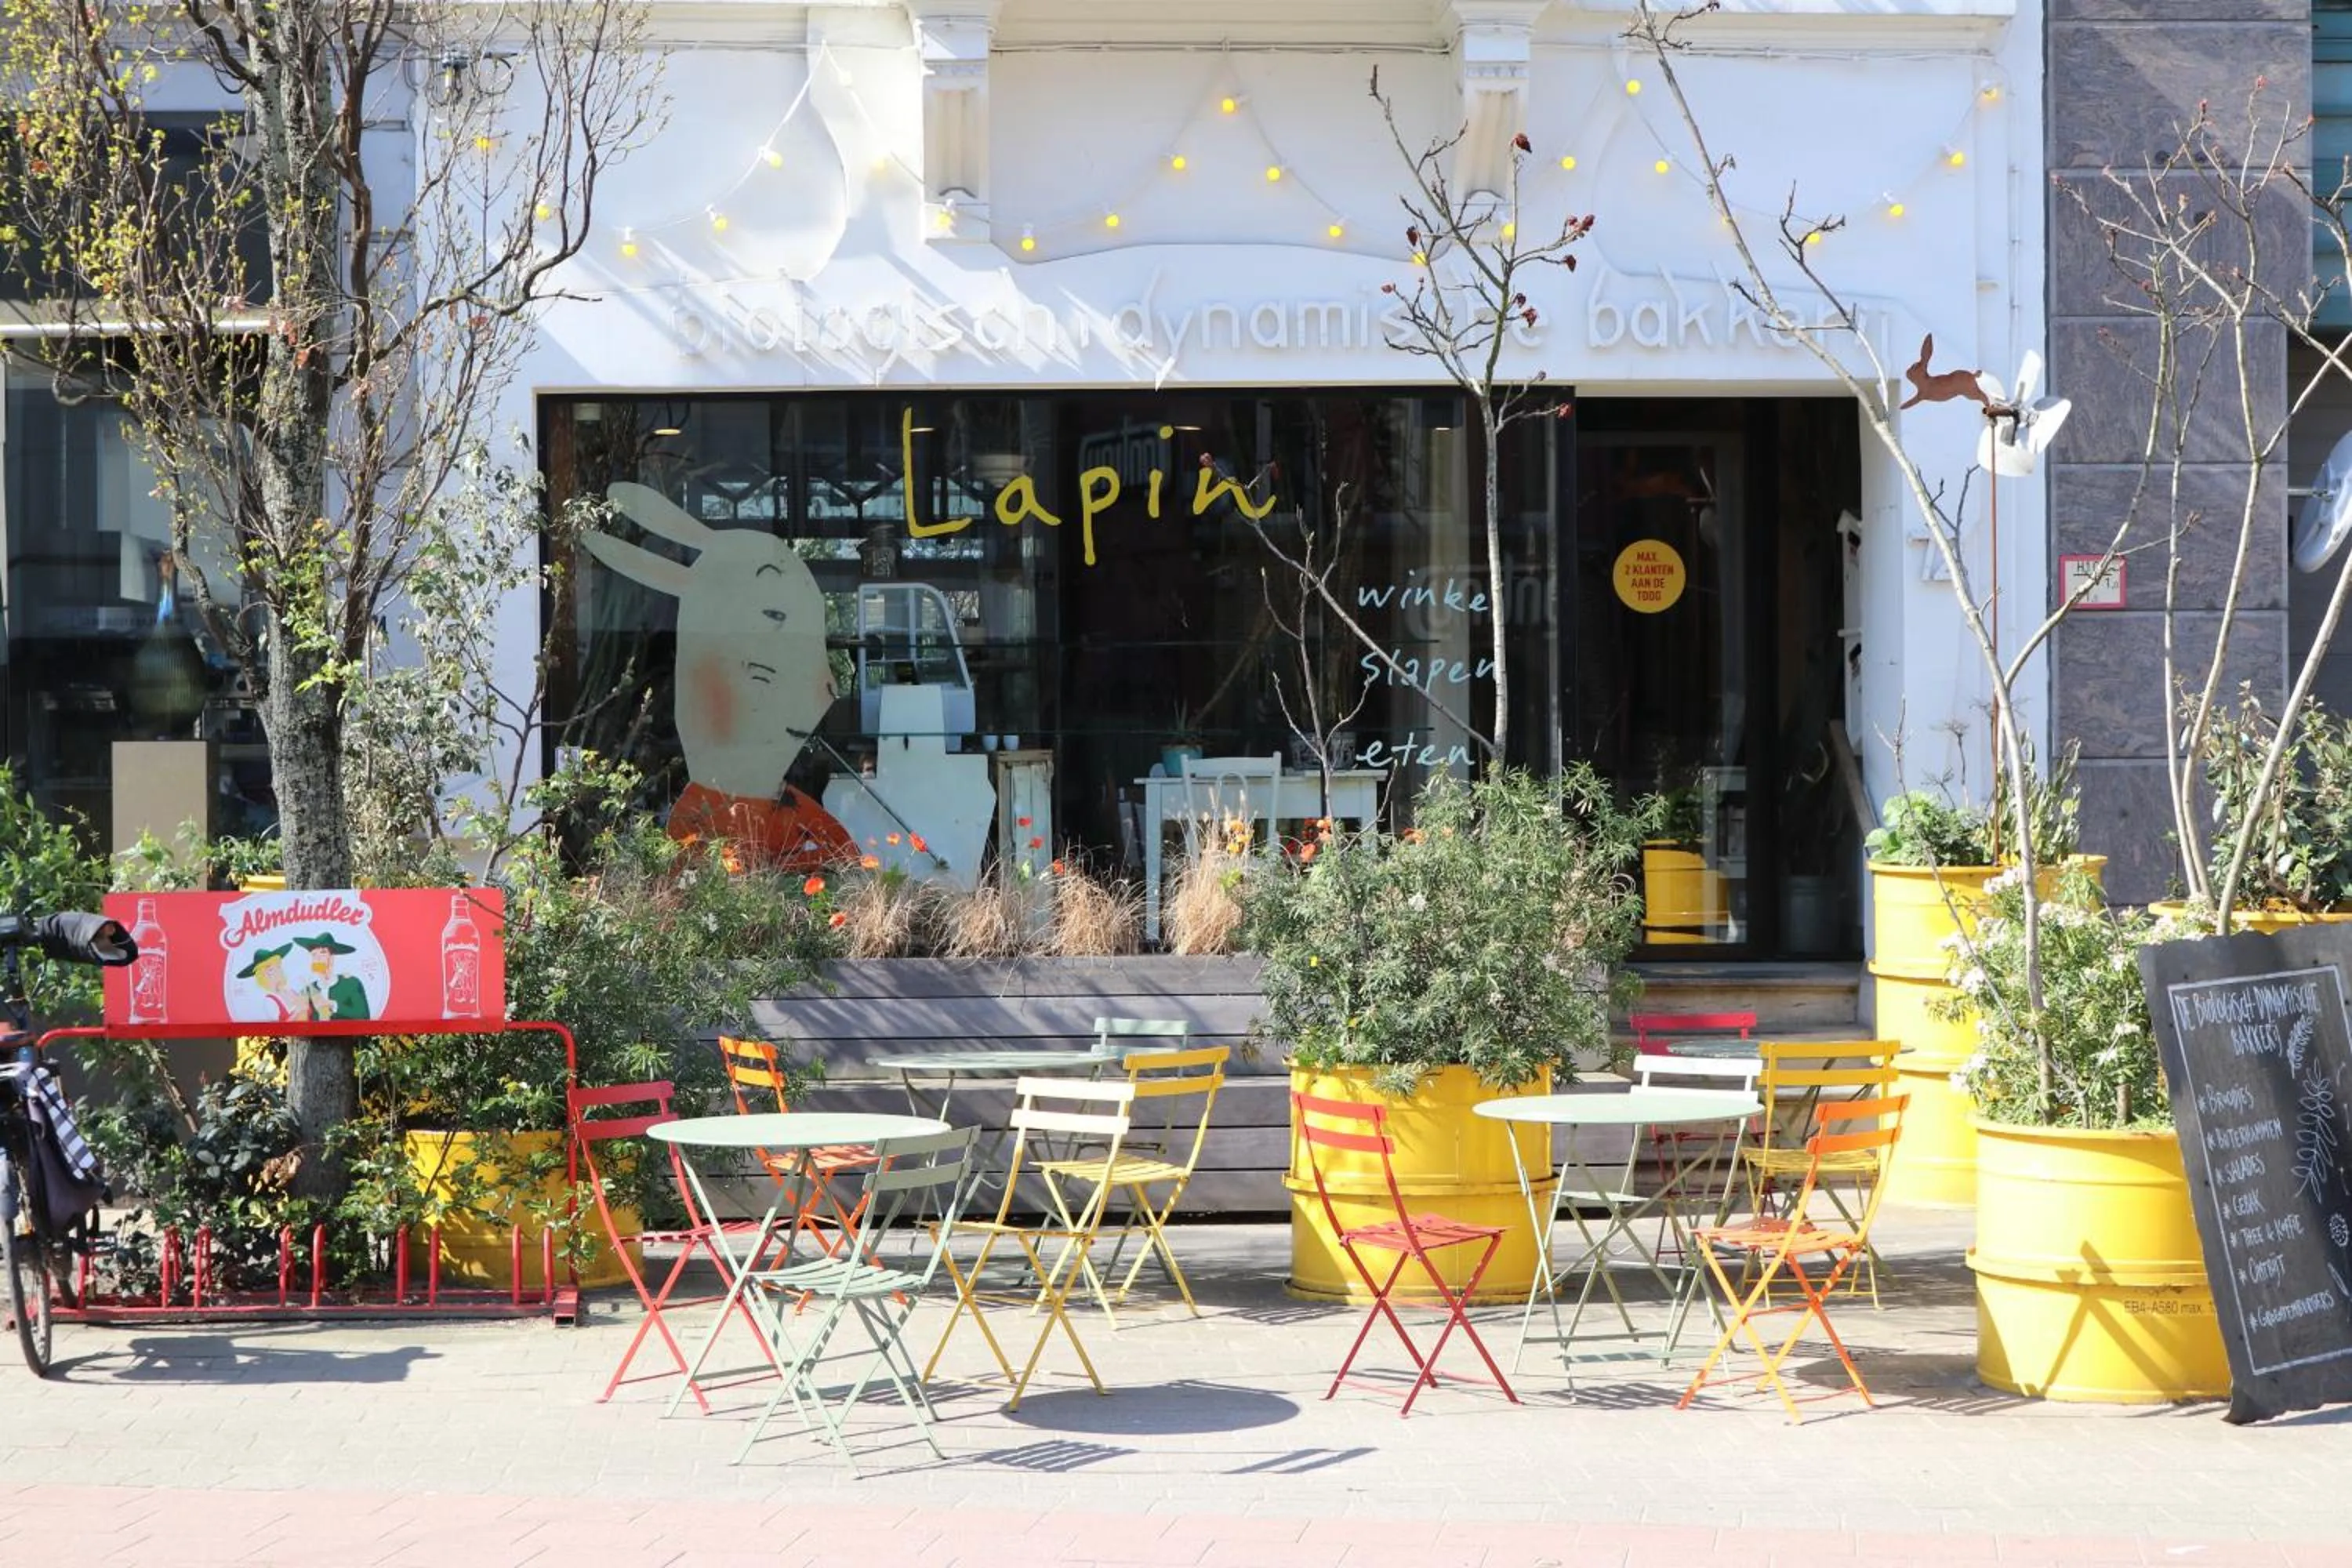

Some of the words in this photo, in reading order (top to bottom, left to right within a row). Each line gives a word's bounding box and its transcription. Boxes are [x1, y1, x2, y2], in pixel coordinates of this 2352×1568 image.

[903, 406, 1276, 565] Lapin
[1625, 564, 1631, 575] 2
[1632, 564, 1674, 575] KLANTEN
[1632, 579, 1651, 588] AAN
[1653, 579, 1665, 588] DE
[1358, 570, 1489, 612] winke
[1356, 732, 1475, 767] eten
[225, 896, 366, 947] Almdudler
